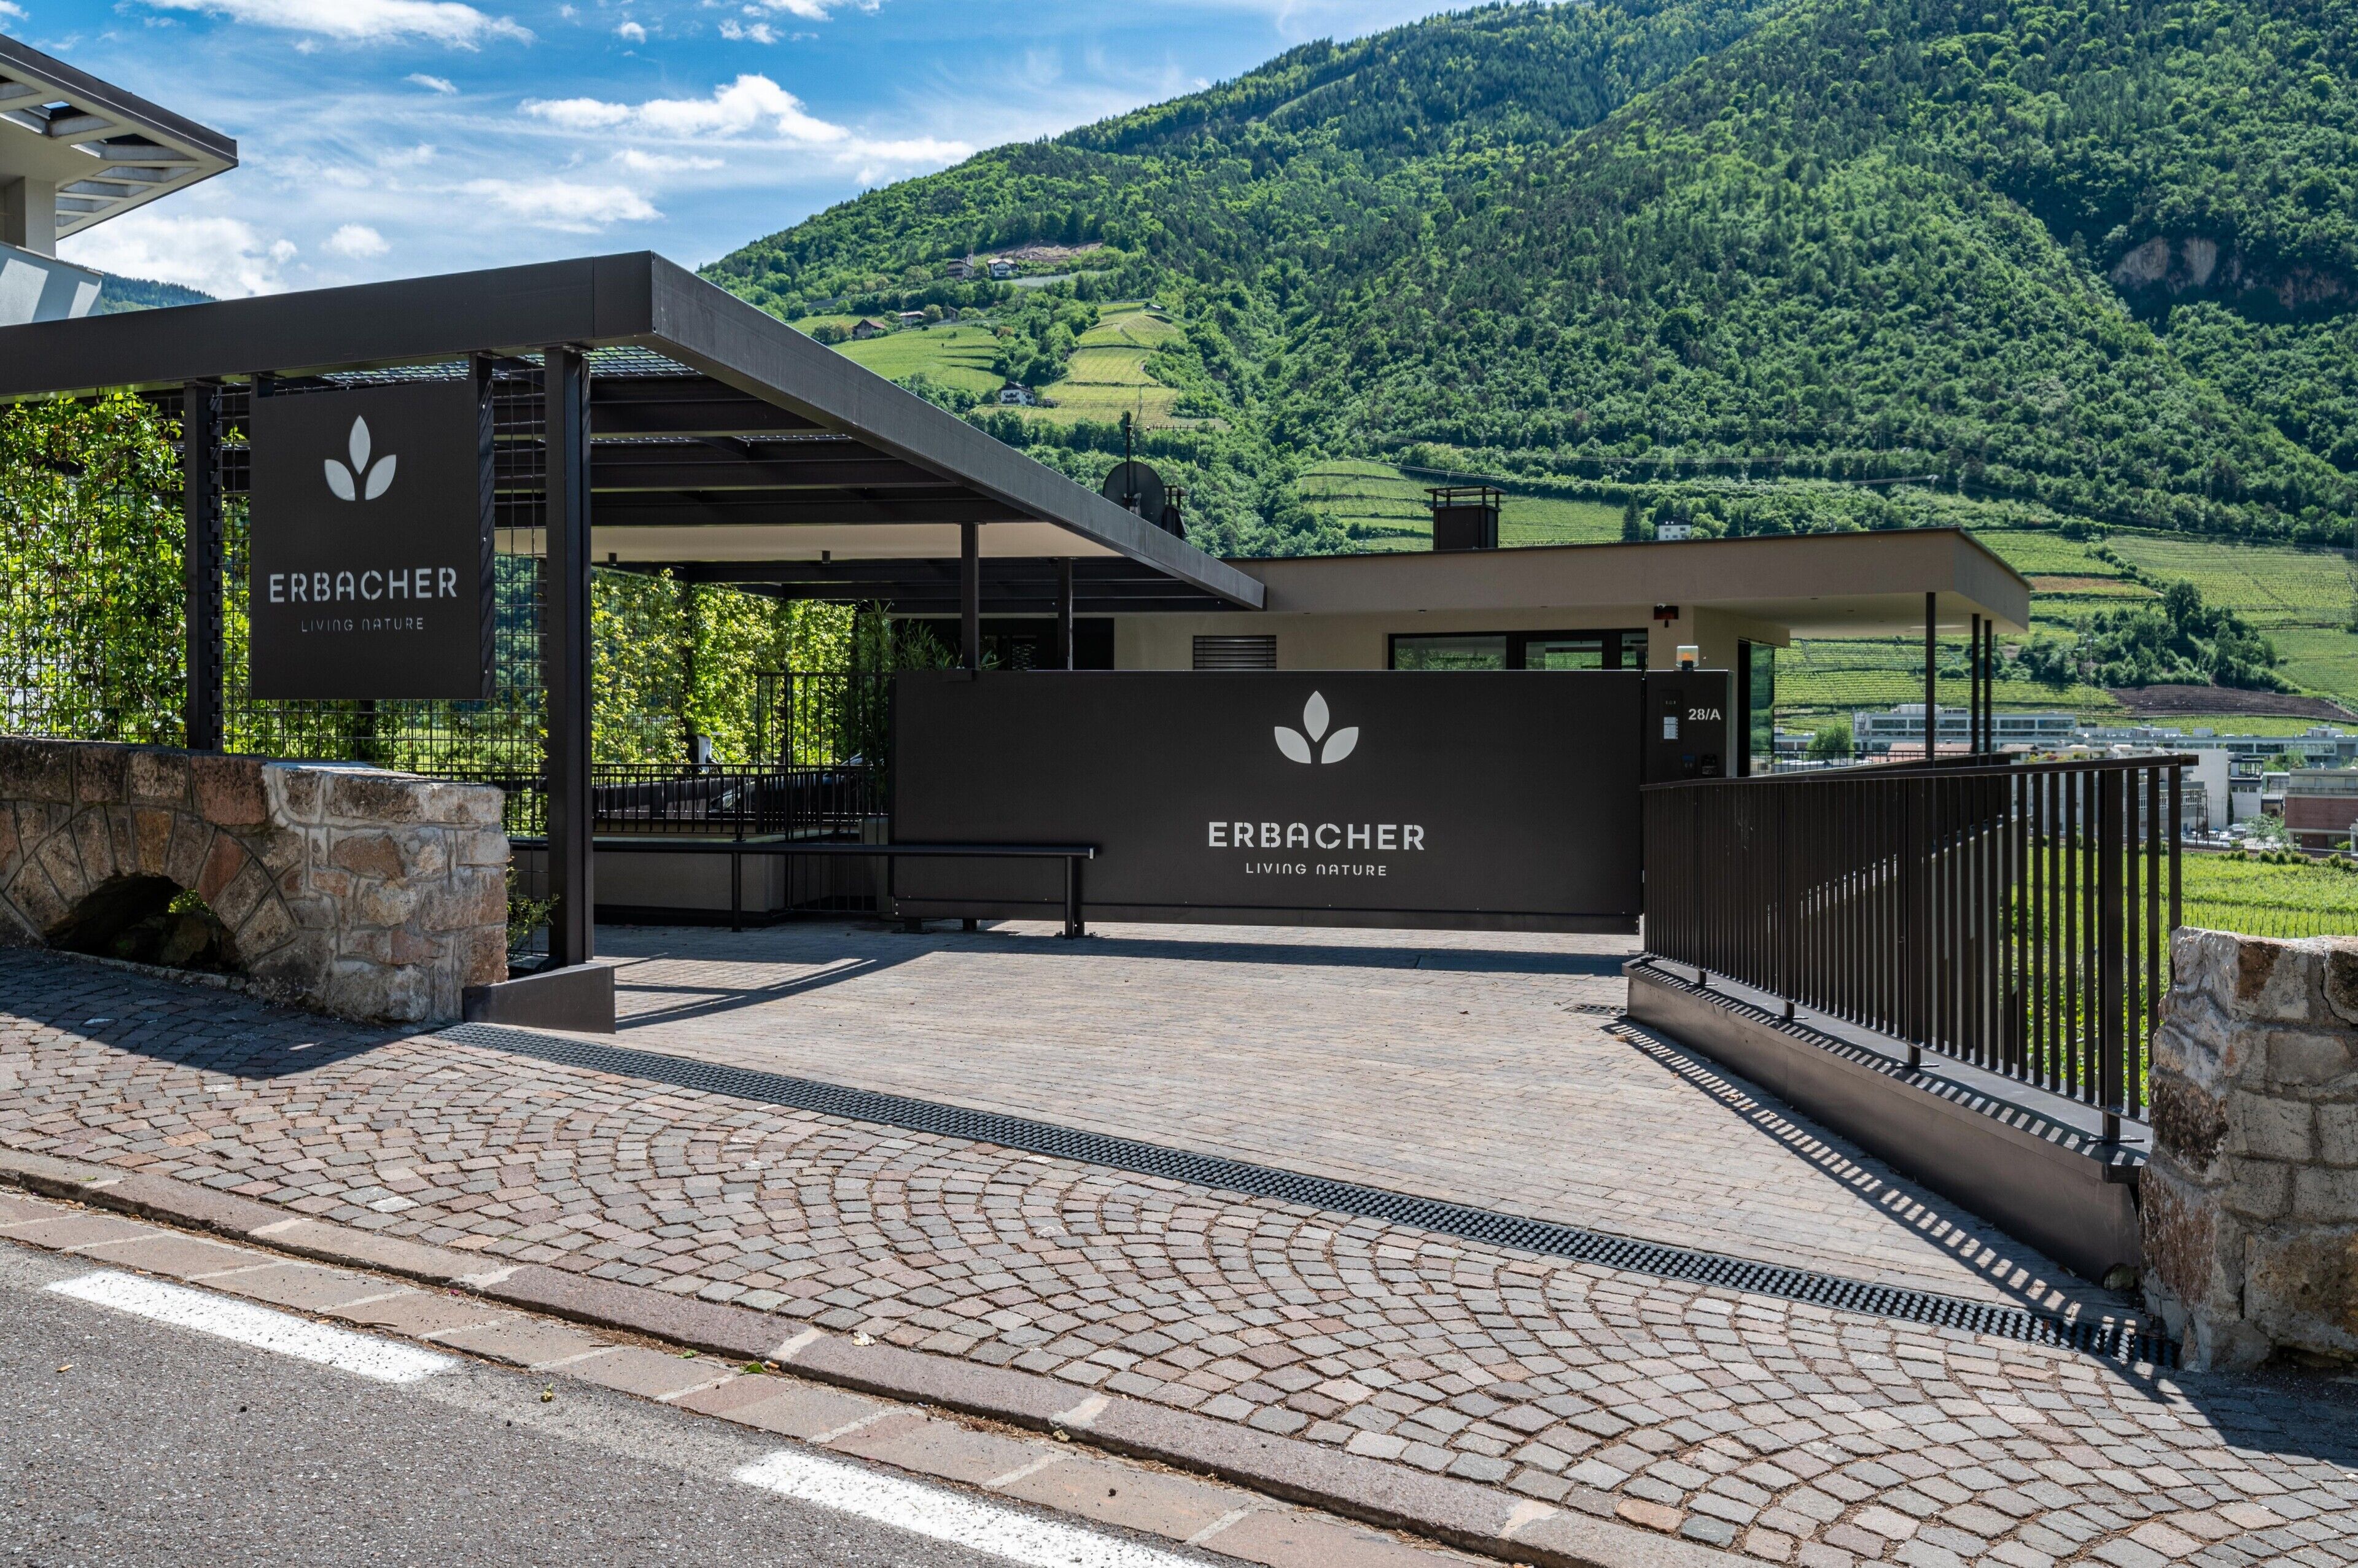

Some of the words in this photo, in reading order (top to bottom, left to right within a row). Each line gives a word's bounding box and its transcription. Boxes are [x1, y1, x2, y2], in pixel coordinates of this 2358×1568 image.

[270, 567, 458, 603] ERBACHER
[302, 619, 353, 632] LIVING
[362, 617, 424, 631] NATURE
[1688, 708, 1721, 720] 28/A
[1208, 821, 1425, 850] ERBACHER
[1246, 863, 1307, 875] LIVING
[1316, 864, 1387, 876] NATURE
